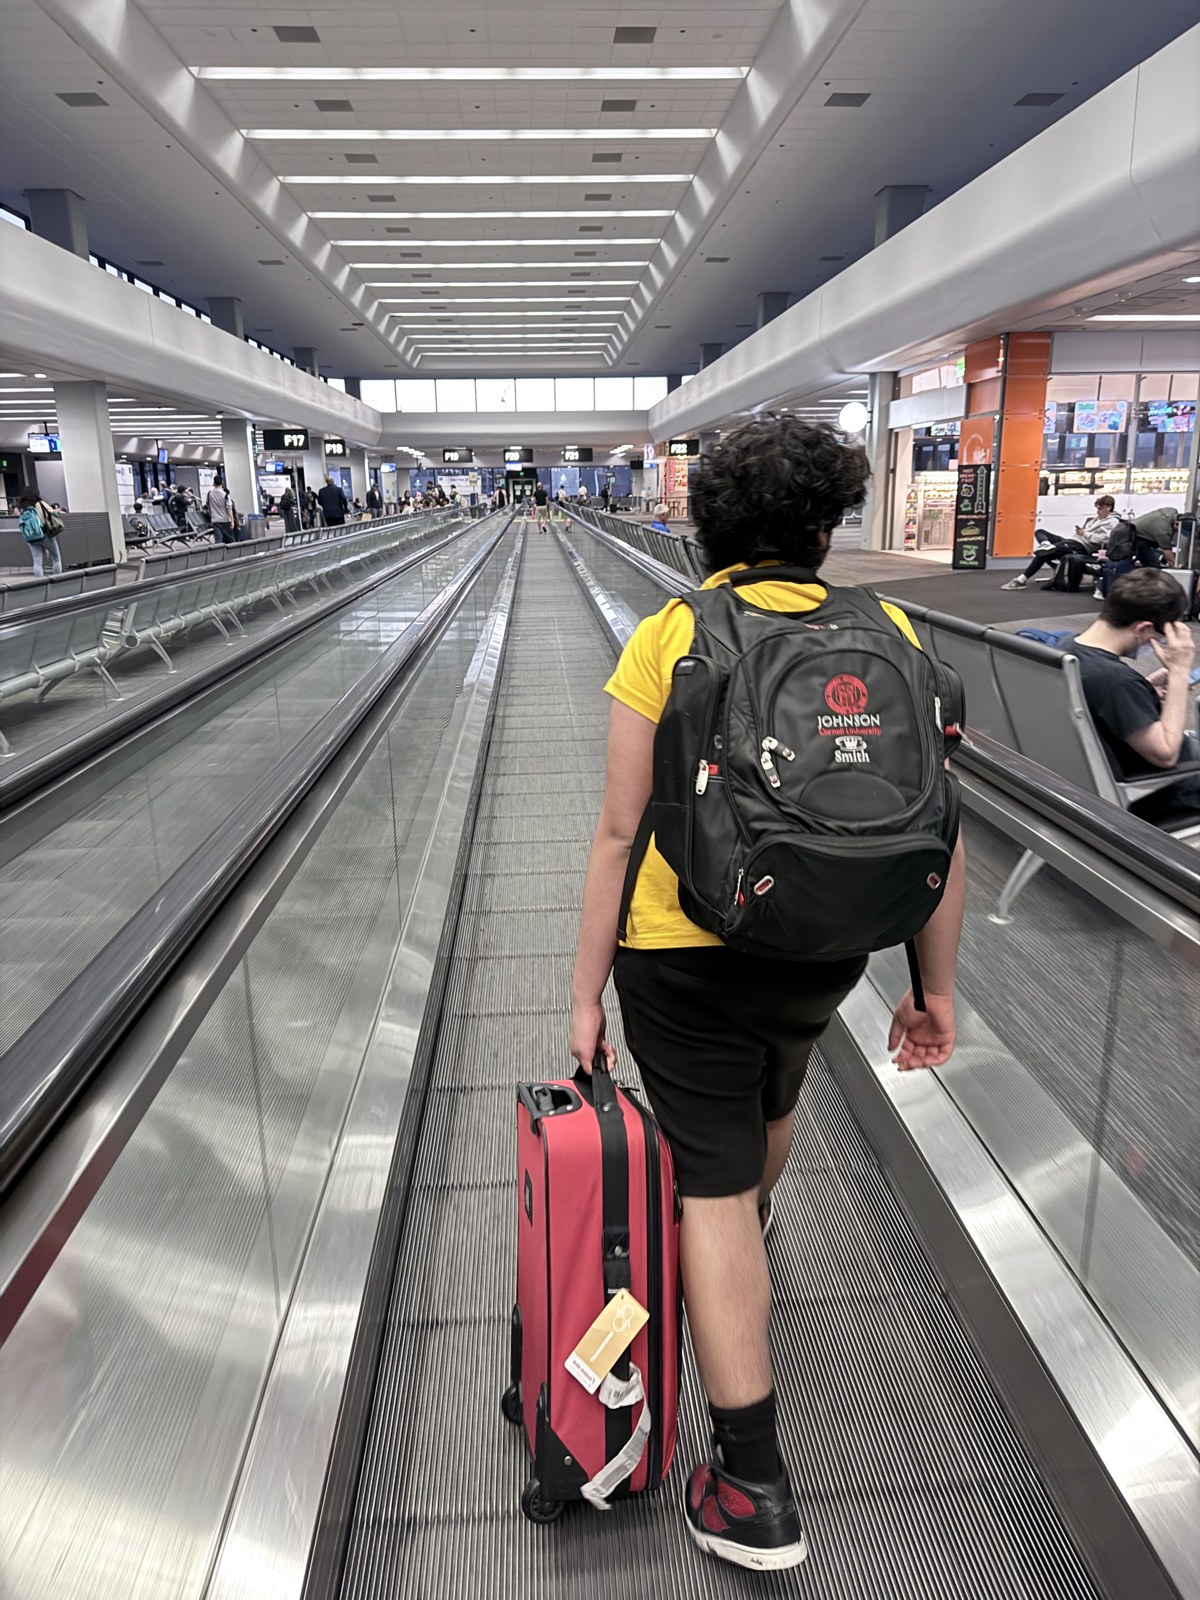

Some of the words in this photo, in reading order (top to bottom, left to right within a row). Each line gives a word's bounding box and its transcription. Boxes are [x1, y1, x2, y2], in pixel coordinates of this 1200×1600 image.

[284, 434, 305, 447] F17
[325, 443, 343, 454] F18
[671, 443, 688, 453] F22
[444, 452, 459, 461] F19
[504, 452, 520, 460] F20
[565, 451, 579, 460] F21
[817, 714, 881, 729] JOHNSON
[818, 728, 844, 736] Cornell
[846, 727, 881, 737] University
[834, 749, 870, 763] Smith
